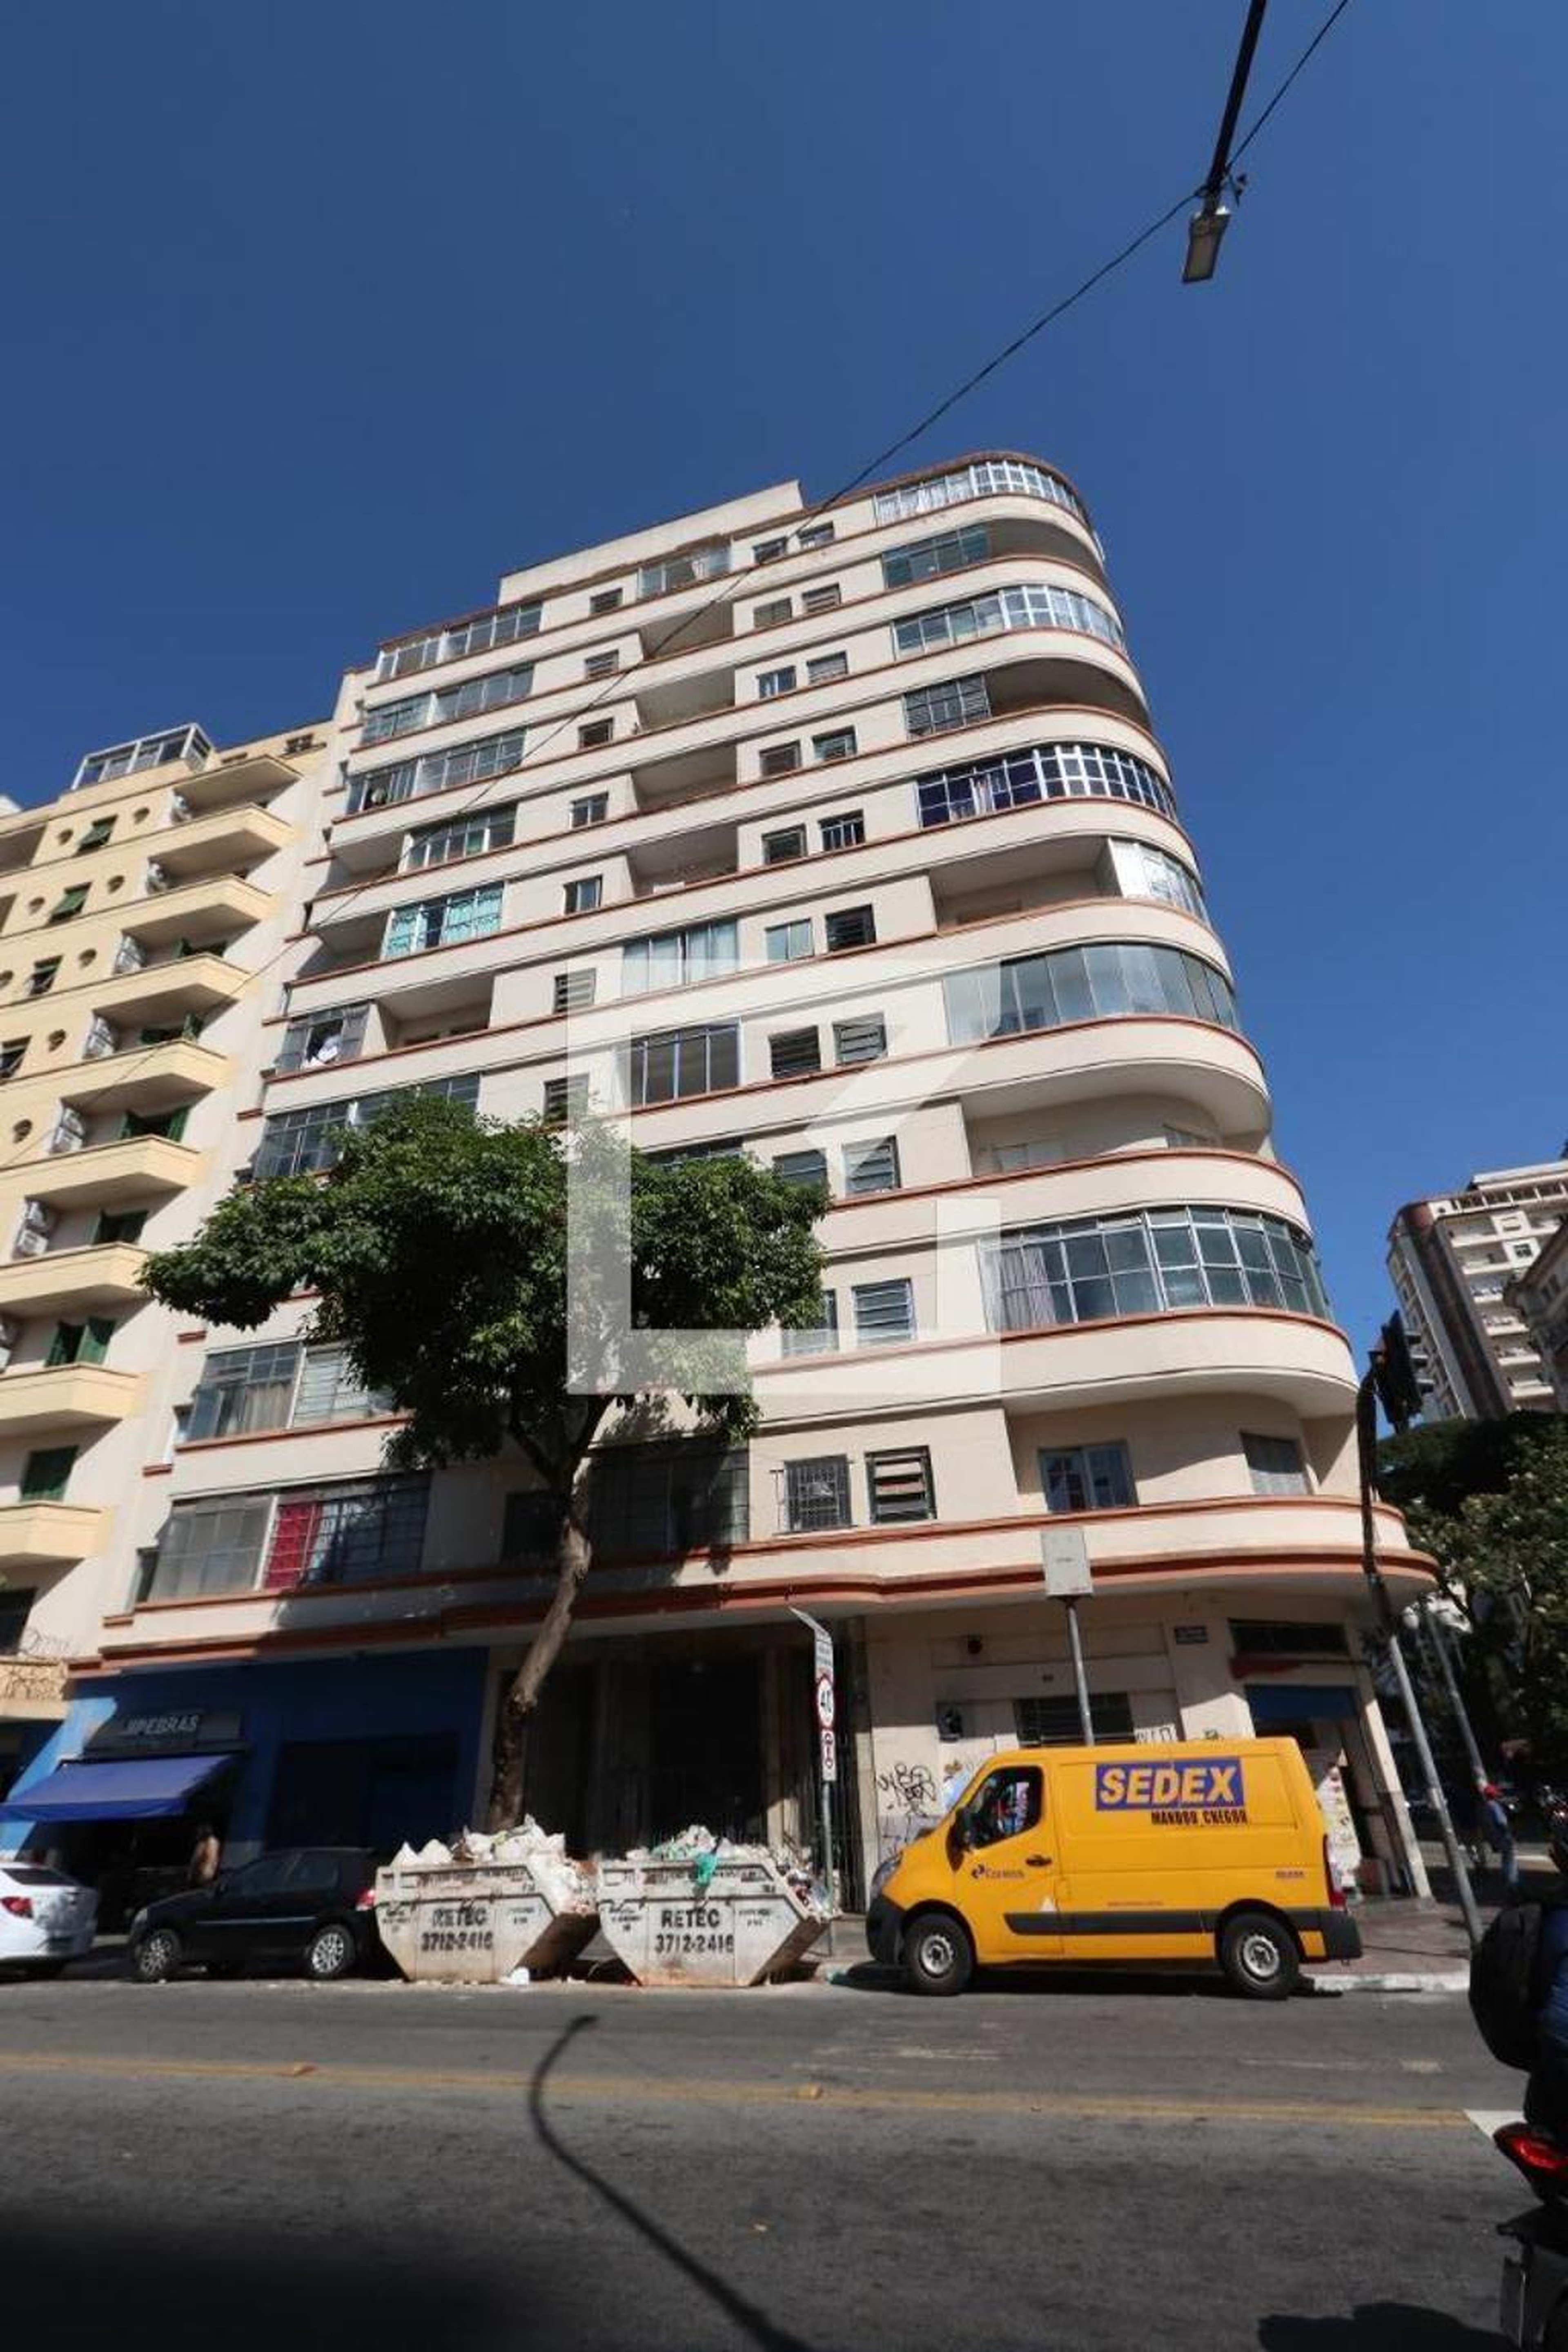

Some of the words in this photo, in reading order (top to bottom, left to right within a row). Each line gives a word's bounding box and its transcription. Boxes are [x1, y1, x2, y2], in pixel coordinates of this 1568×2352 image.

[1100, 1766, 1236, 1805] SEDEX
[432, 1907, 487, 1927] RETEC
[661, 1907, 720, 1928] RETEC
